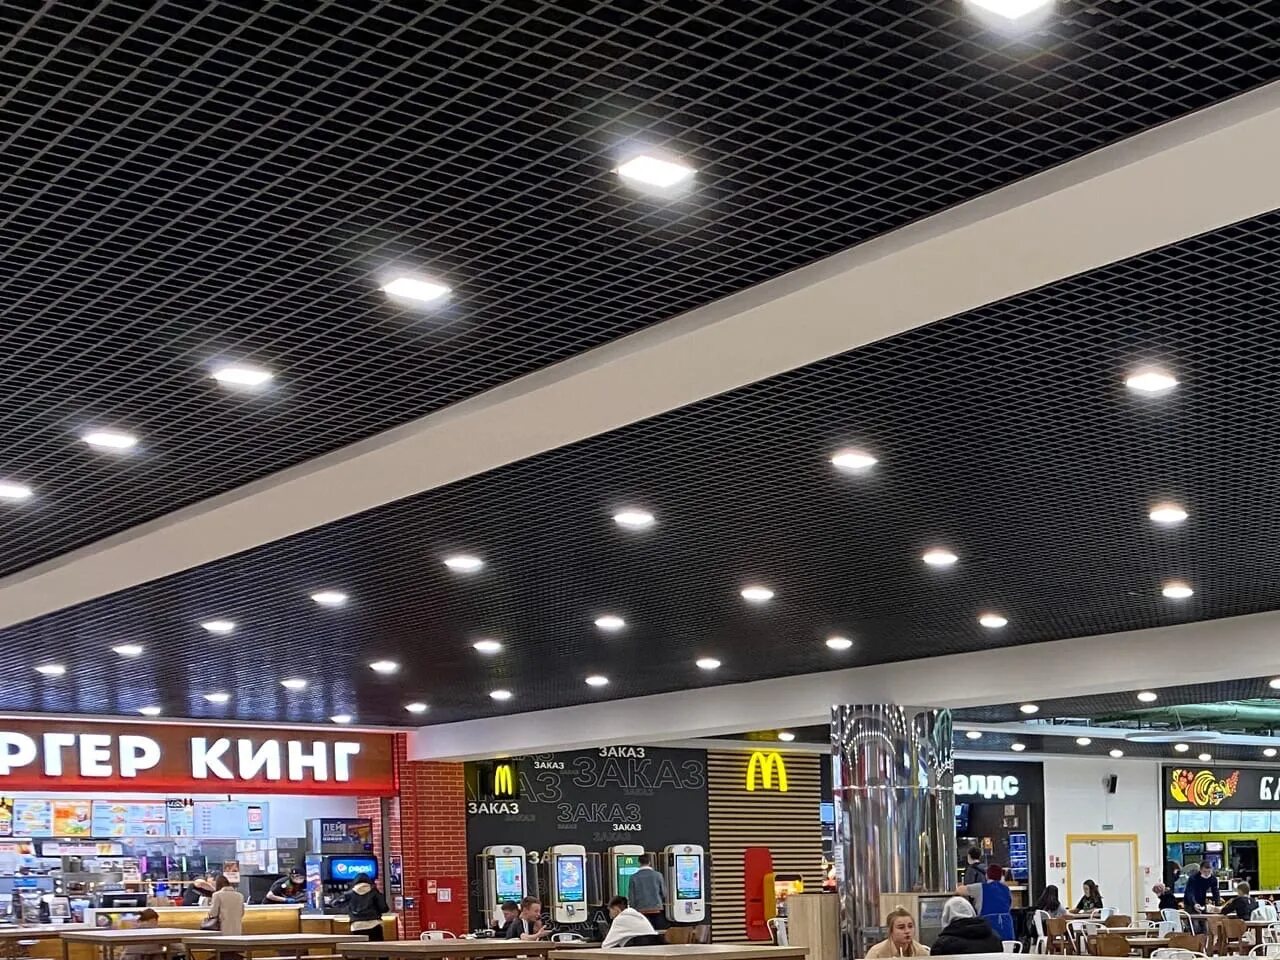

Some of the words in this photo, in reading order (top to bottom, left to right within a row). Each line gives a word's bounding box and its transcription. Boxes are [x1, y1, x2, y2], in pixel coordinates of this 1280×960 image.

[599, 747, 645, 758] ЗАКАЗ
[191, 737, 361, 781] КИНГ
[534, 761, 565, 769] ЗАКАЗ
[572, 756, 705, 789] ЗАКАЗ
[468, 802, 519, 814] ЗАКАЗ
[557, 803, 641, 823] ЗАКАЗ
[612, 823, 642, 831] ЗАКАЗ
